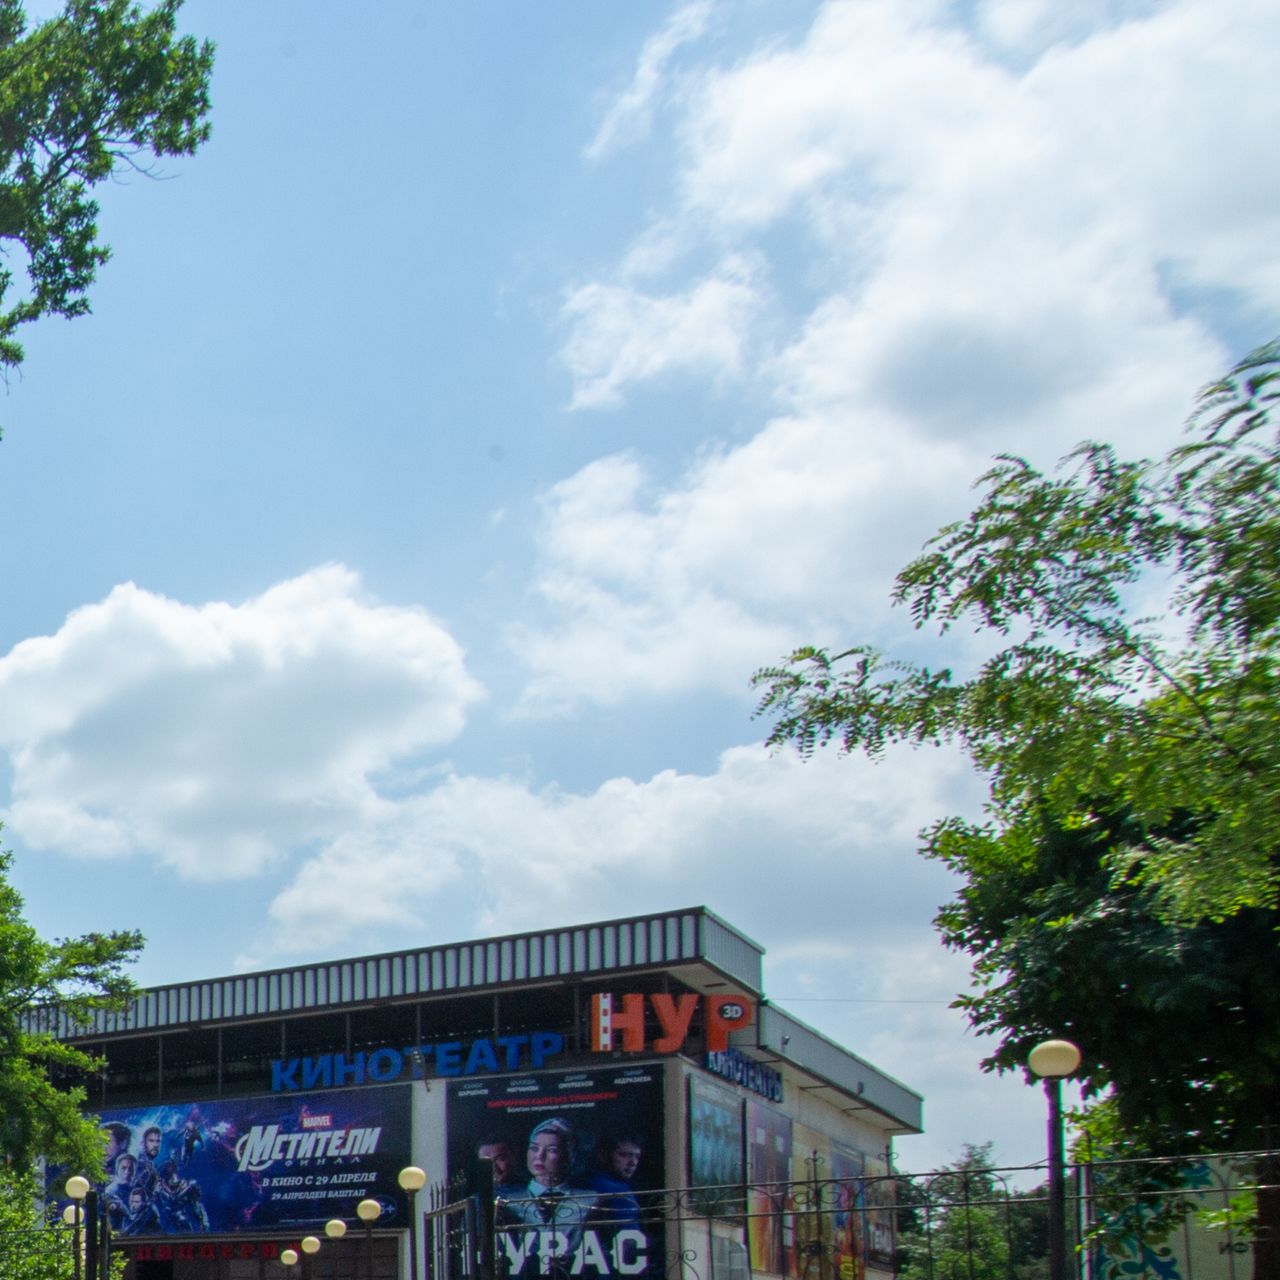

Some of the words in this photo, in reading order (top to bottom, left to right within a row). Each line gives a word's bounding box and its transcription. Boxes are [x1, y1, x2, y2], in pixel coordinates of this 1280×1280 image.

[722, 1004, 742, 1019] 3D
[270, 1031, 564, 1093] КИНОТЕАТР
[591, 993, 753, 1053] НУР
[302, 1115, 331, 1128] MARVEL
[262, 1177, 270, 1187] В
[271, 1175, 304, 1187] КИНО
[304, 1175, 314, 1185] С
[315, 1175, 329, 1186] 29
[330, 1172, 377, 1183] АПРЕЛЯ
[271, 1192, 281, 1200] 29
[461, 1229, 648, 1275] УРАС
